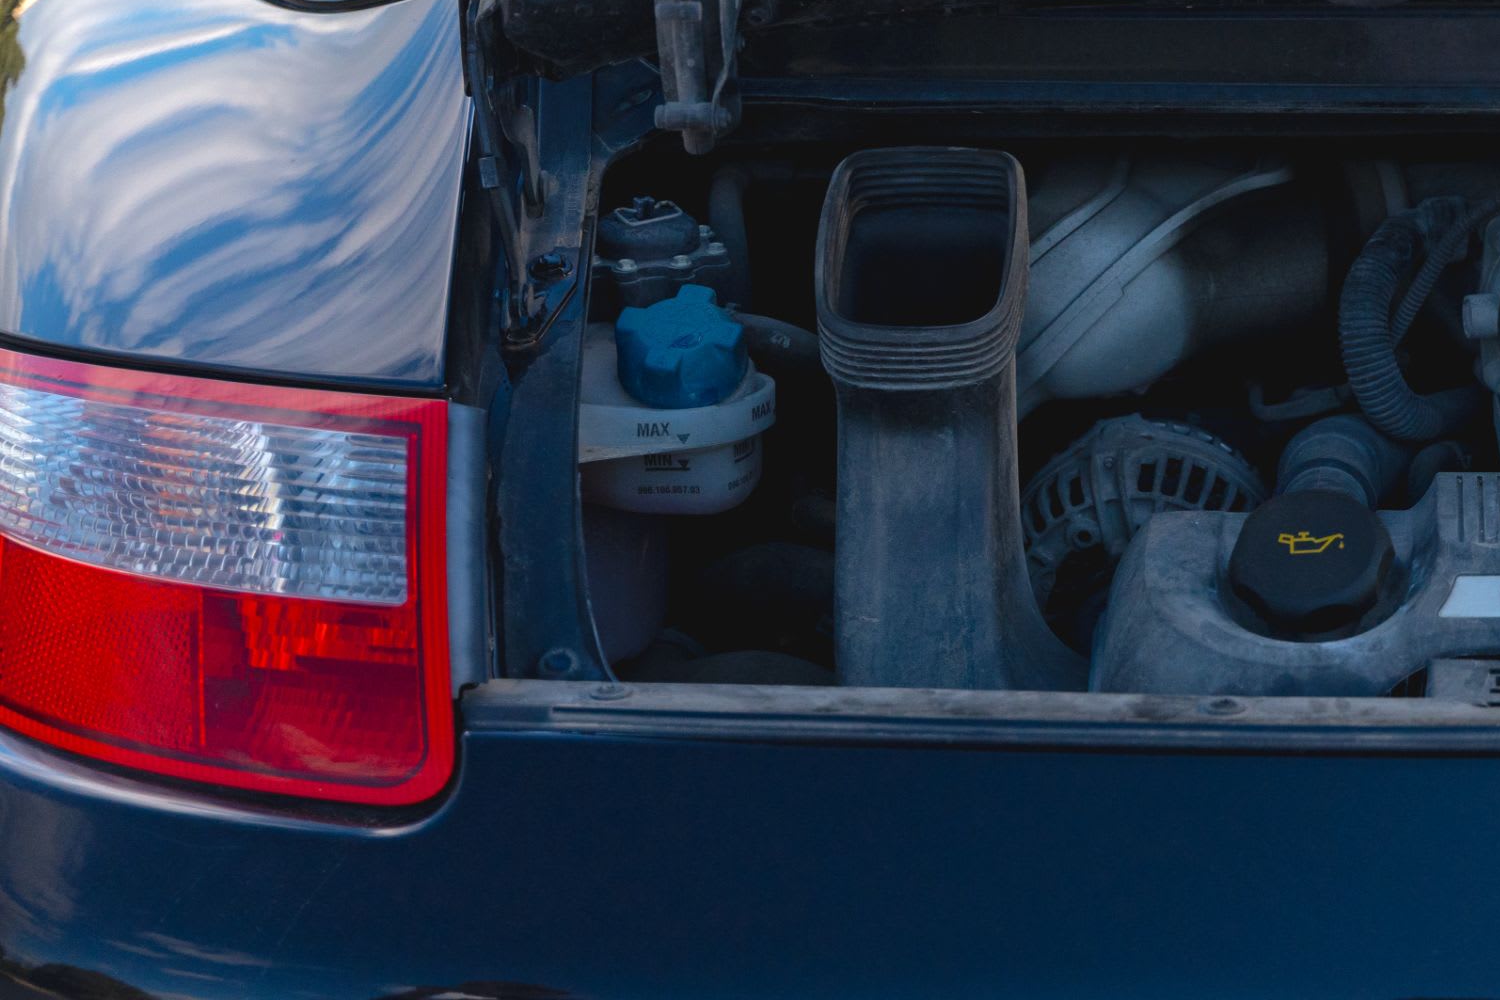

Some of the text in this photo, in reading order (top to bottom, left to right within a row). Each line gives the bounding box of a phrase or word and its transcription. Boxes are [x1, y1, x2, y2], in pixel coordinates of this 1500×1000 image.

[752, 400, 772, 421] MAX
[636, 422, 671, 438] MAX
[643, 453, 673, 467] MIN
